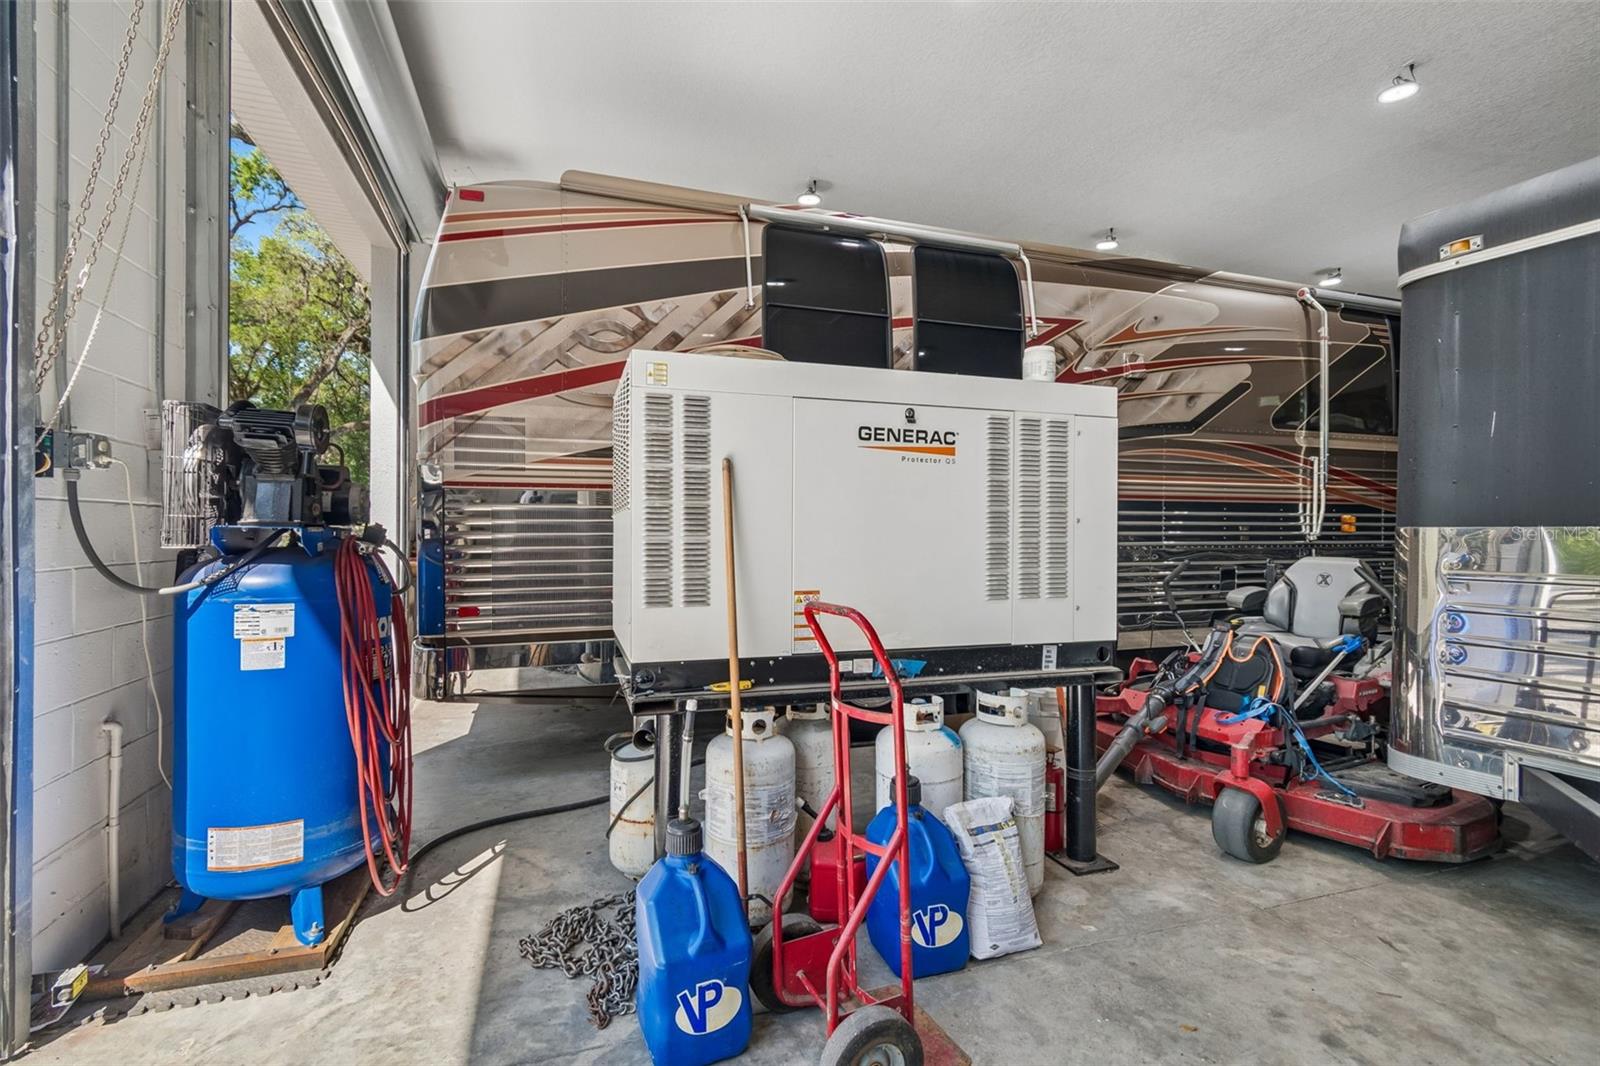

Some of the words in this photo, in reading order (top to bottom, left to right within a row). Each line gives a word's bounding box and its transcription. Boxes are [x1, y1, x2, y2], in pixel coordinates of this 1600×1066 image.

[857, 425, 957, 446] GENERAC
[901, 455, 942, 464] Protector
[912, 903, 950, 947] VP
[676, 979, 725, 1034] VP
